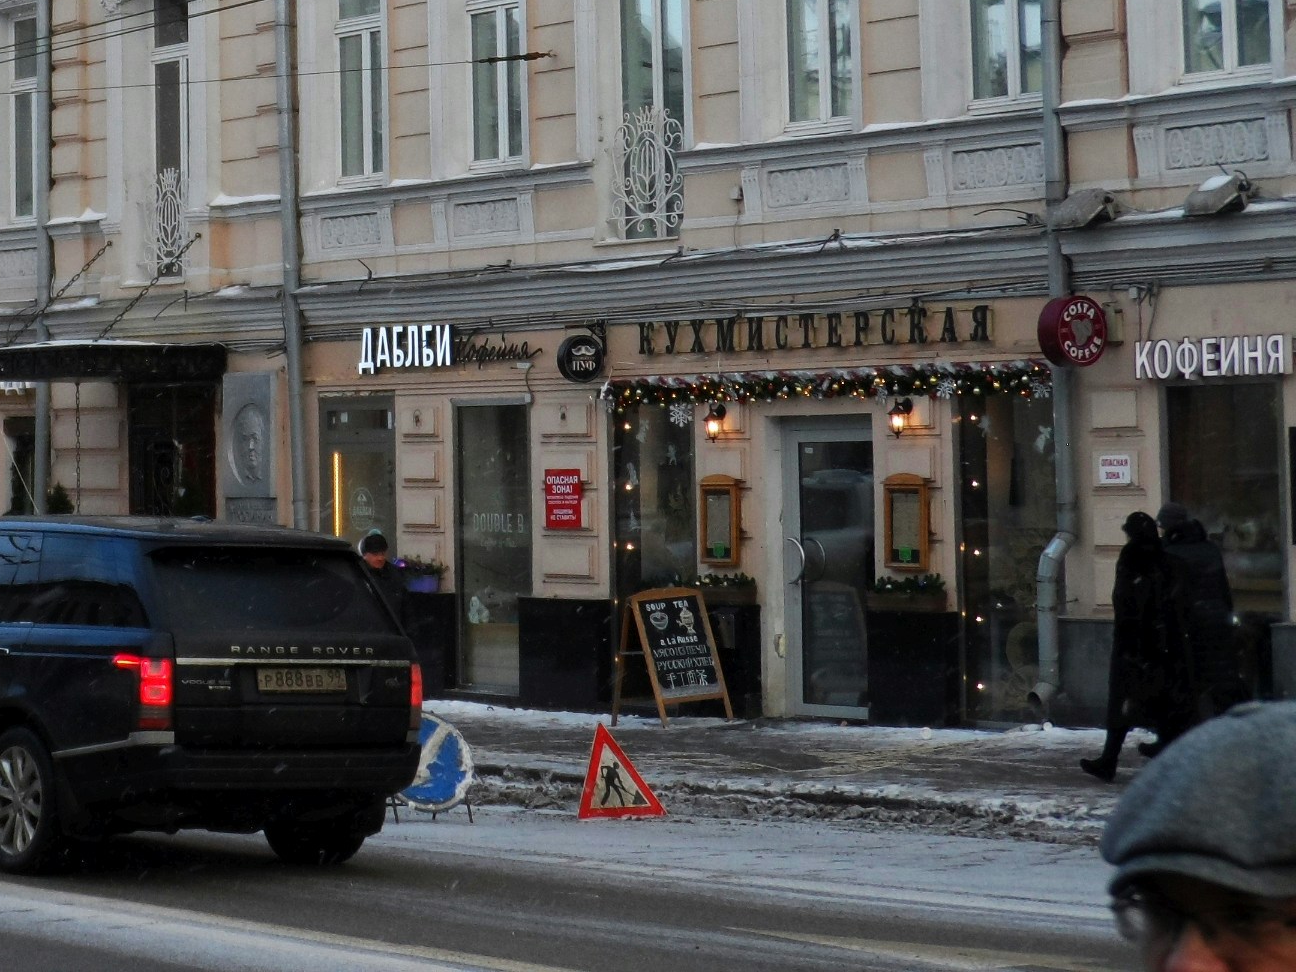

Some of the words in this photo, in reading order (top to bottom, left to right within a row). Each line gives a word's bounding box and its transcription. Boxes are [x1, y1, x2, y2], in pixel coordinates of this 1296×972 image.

[1064, 303, 1095, 321] COSTA
[638, 305, 989, 354] КУХМИСТЕРСКАЯ
[358, 324, 451, 374] ДАБЛБИ
[1064, 336, 1102, 359] COFFEE
[572, 361, 596, 371] ПУФ
[546, 475, 579, 485] ОПАСНАЯ
[551, 484, 573, 494] ЗОНА!
[473, 513, 513, 533] DOUBLE
[517, 513, 525, 534] B
[645, 602, 666, 612] SOUP
[672, 599, 689, 609] TEA
[231, 645, 299, 654] RANGE
[312, 646, 374, 655] ROVER
